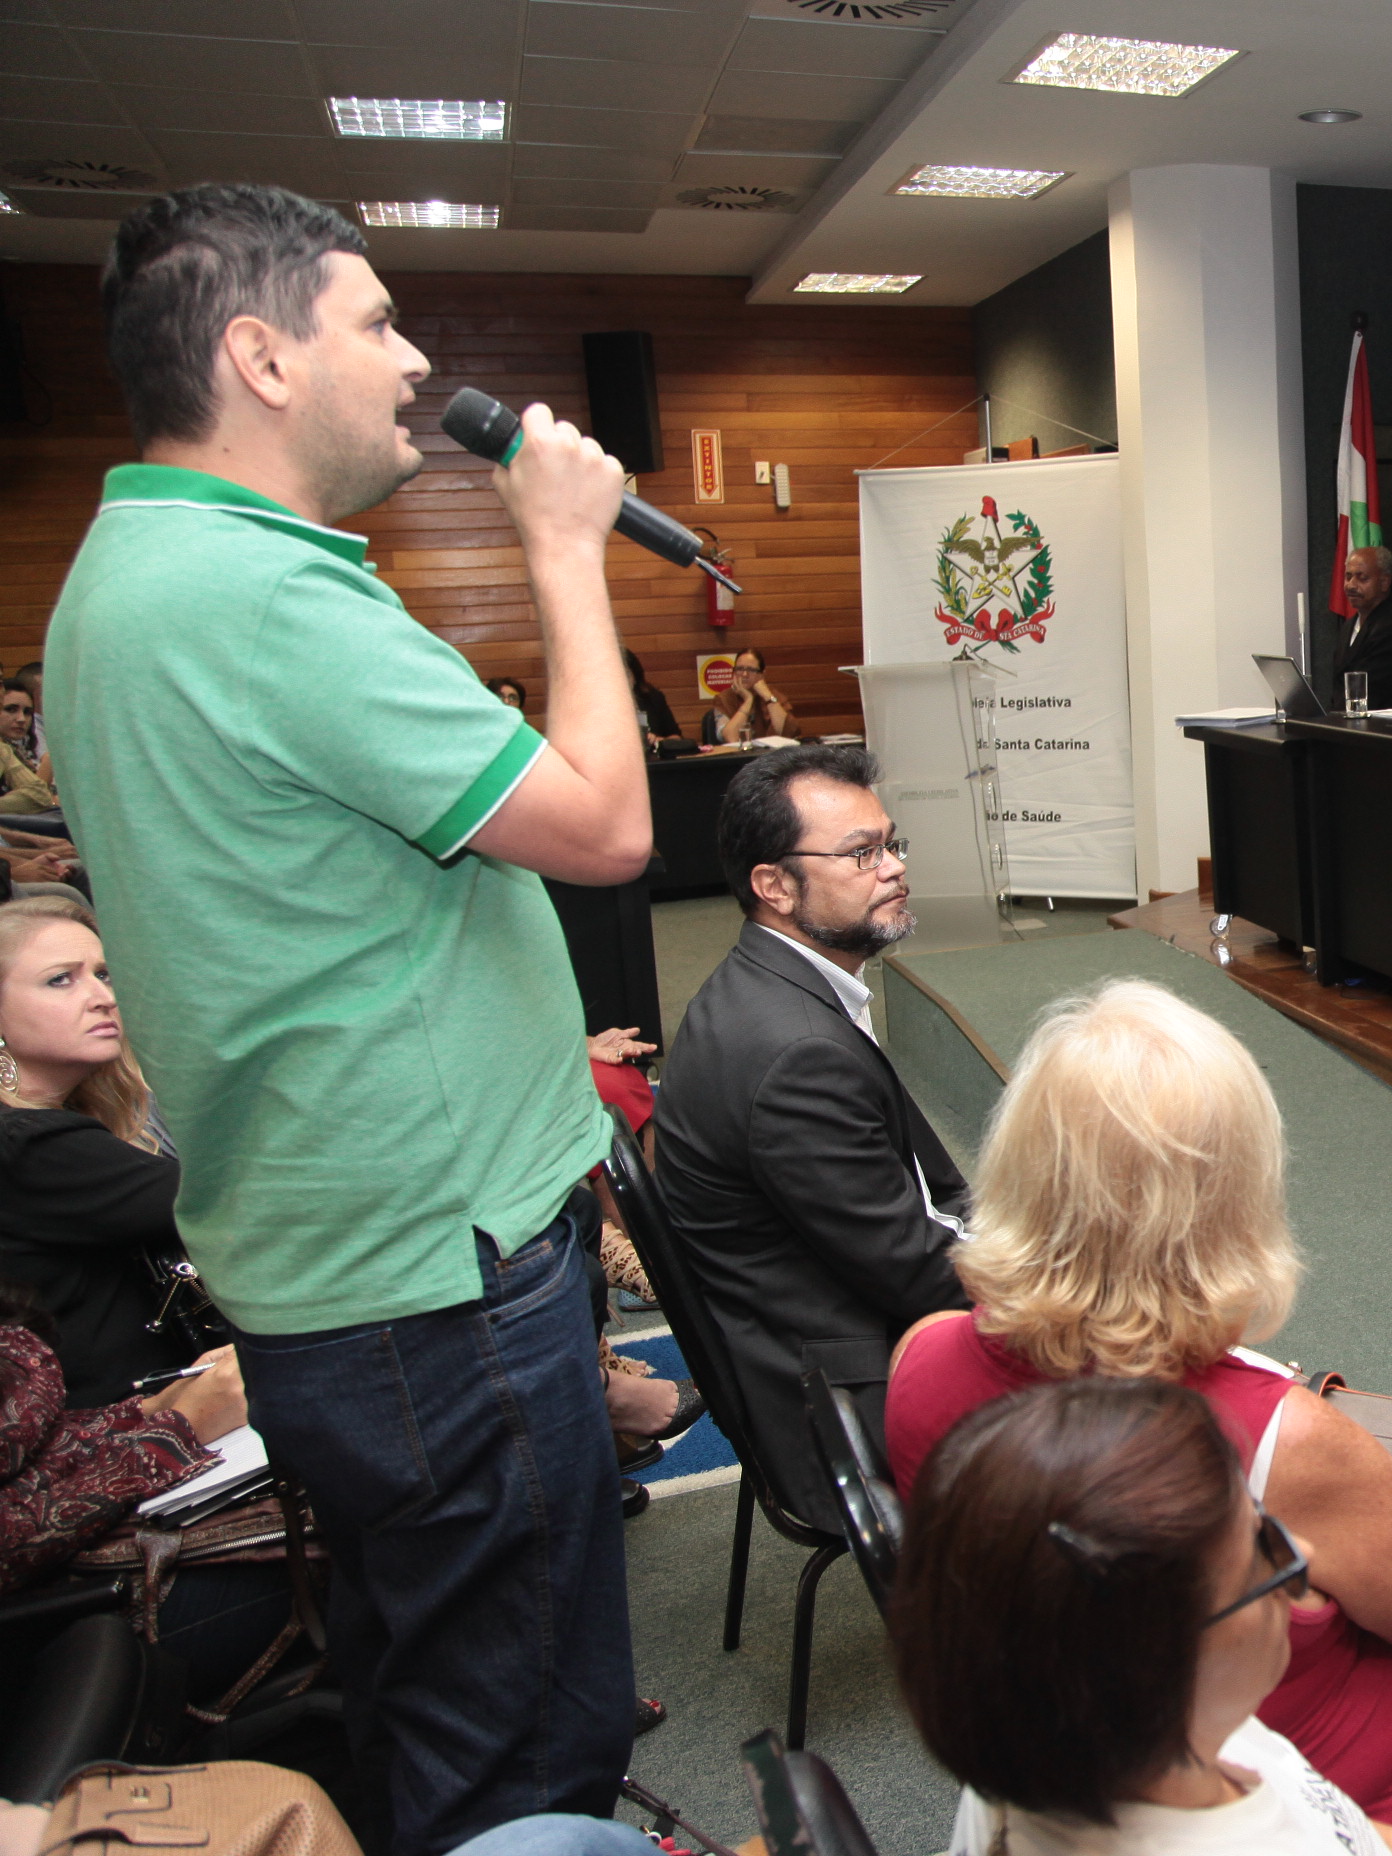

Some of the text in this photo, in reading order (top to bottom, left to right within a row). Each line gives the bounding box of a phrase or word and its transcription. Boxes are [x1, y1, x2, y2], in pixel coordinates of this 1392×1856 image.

[703, 439, 713, 489] EXTINTOR
[945, 626, 973, 637] ESTADO
[974, 631, 984, 640] DE
[1013, 624, 1044, 636] CATARINA
[1000, 696, 1072, 711] Legislativa
[994, 738, 1030, 750] Santa
[1034, 738, 1090, 751] Catarina
[1001, 810, 1017, 822] de
[1021, 810, 1062, 822] Saúde
